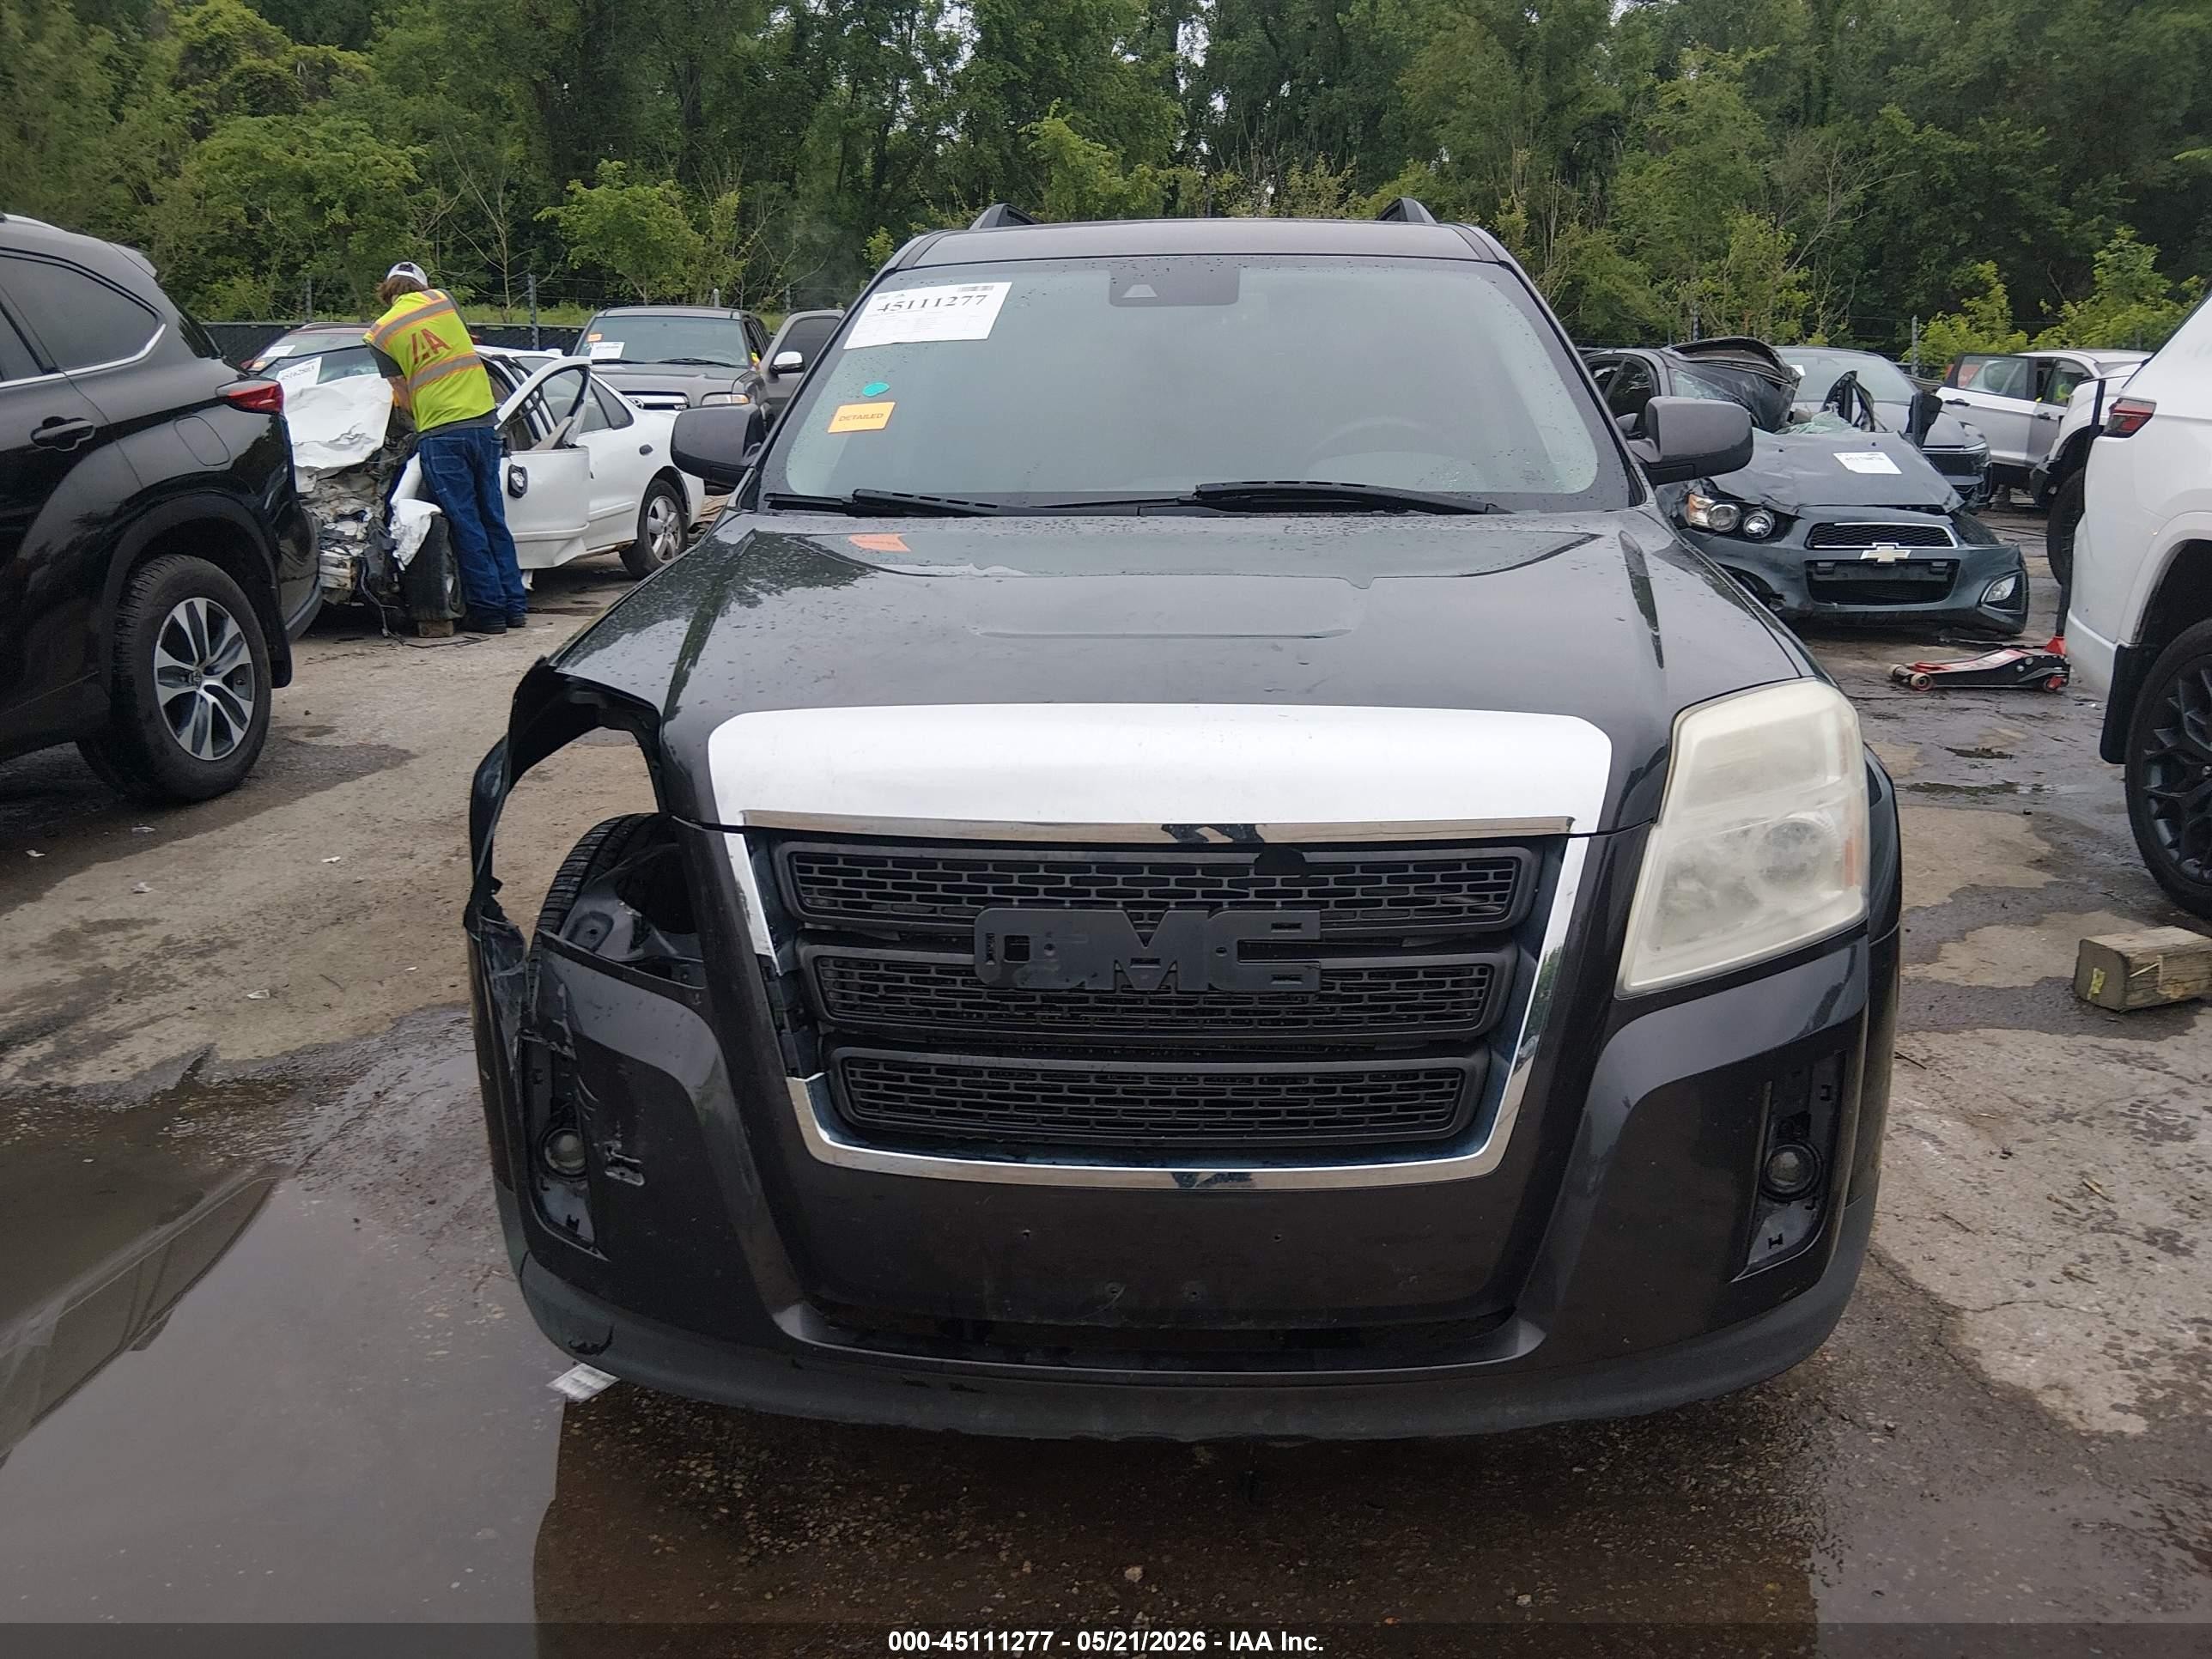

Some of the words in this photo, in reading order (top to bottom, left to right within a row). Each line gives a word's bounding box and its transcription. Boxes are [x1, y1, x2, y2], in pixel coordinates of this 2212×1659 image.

[877, 295, 988, 313] 45111277
[838, 413, 884, 422] DETAILED
[974, 908, 1321, 993] GMC
